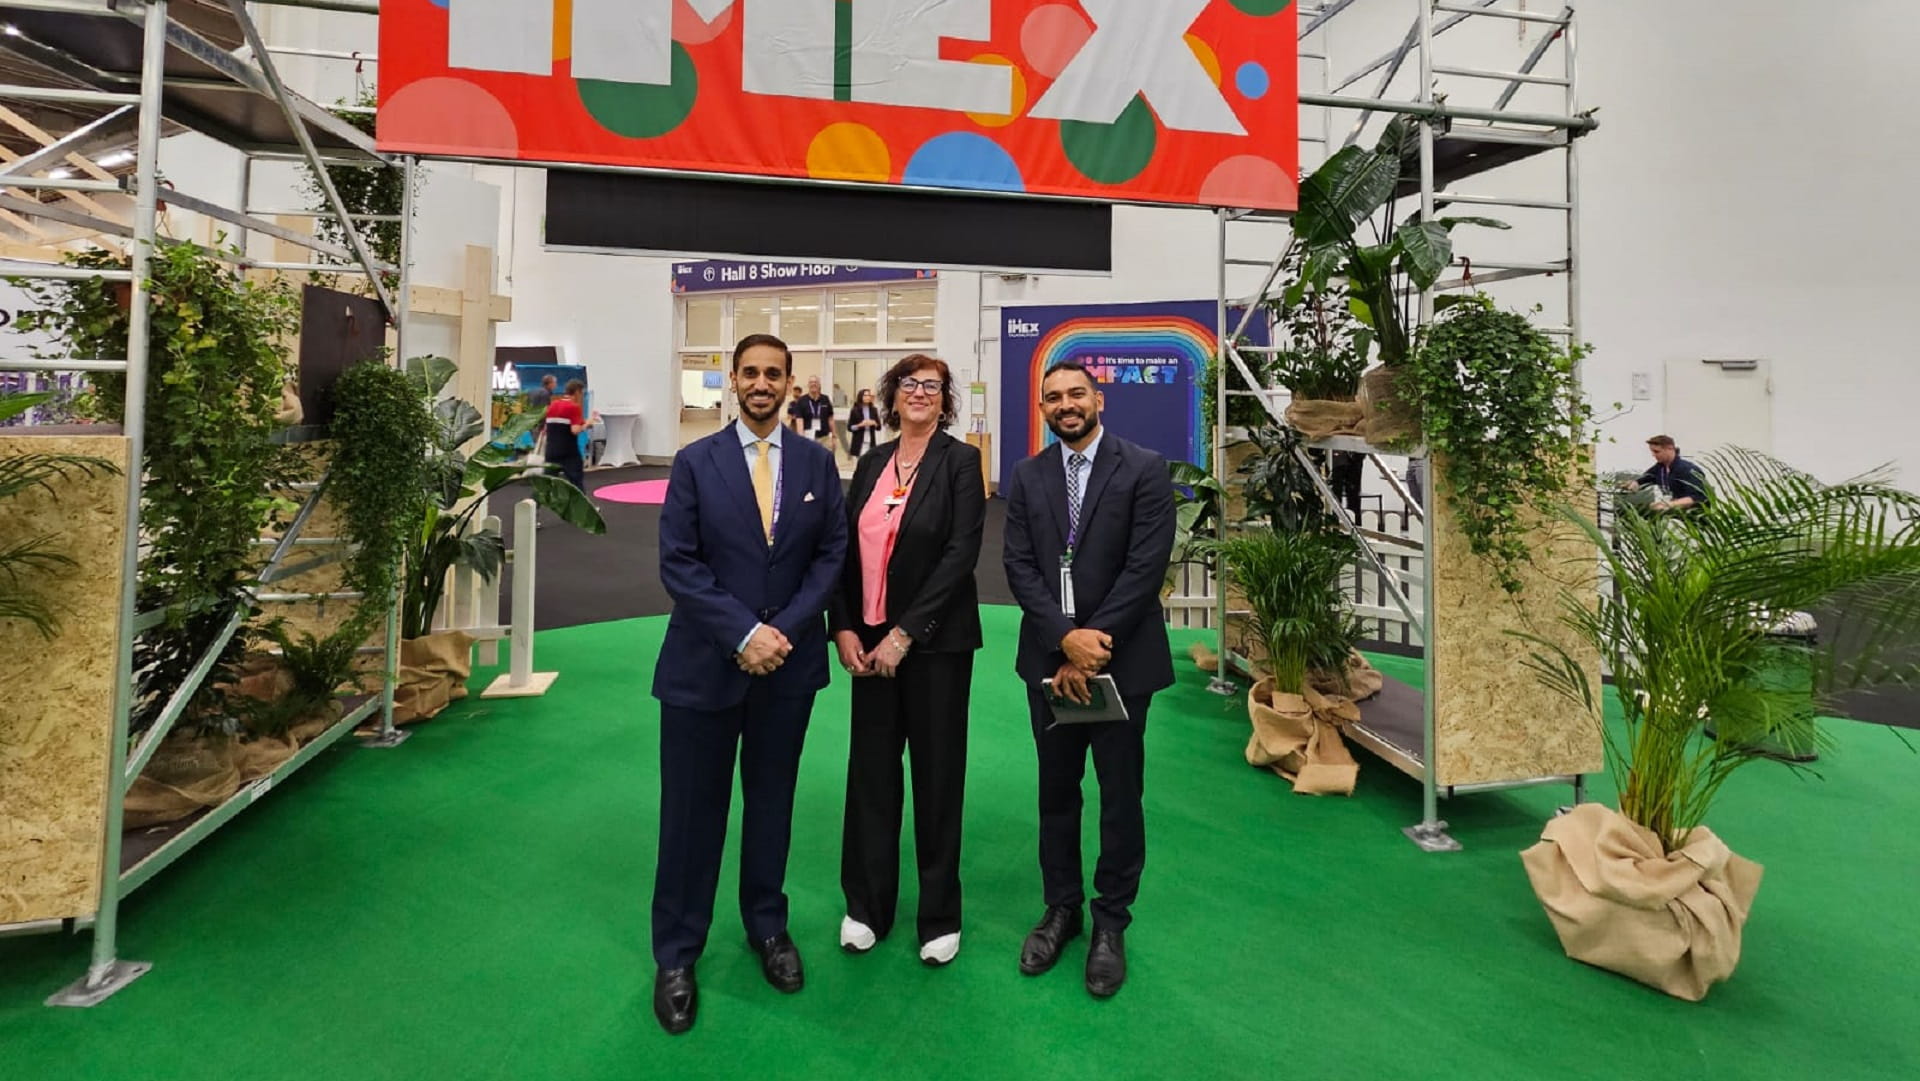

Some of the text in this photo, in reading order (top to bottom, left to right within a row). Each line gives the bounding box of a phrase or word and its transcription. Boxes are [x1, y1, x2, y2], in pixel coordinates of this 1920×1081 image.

[721, 262, 836, 281] Hall 8 Show Floor
[1117, 357, 1135, 365] time
[1136, 357, 1145, 365] to
[1146, 356, 1167, 365] make
